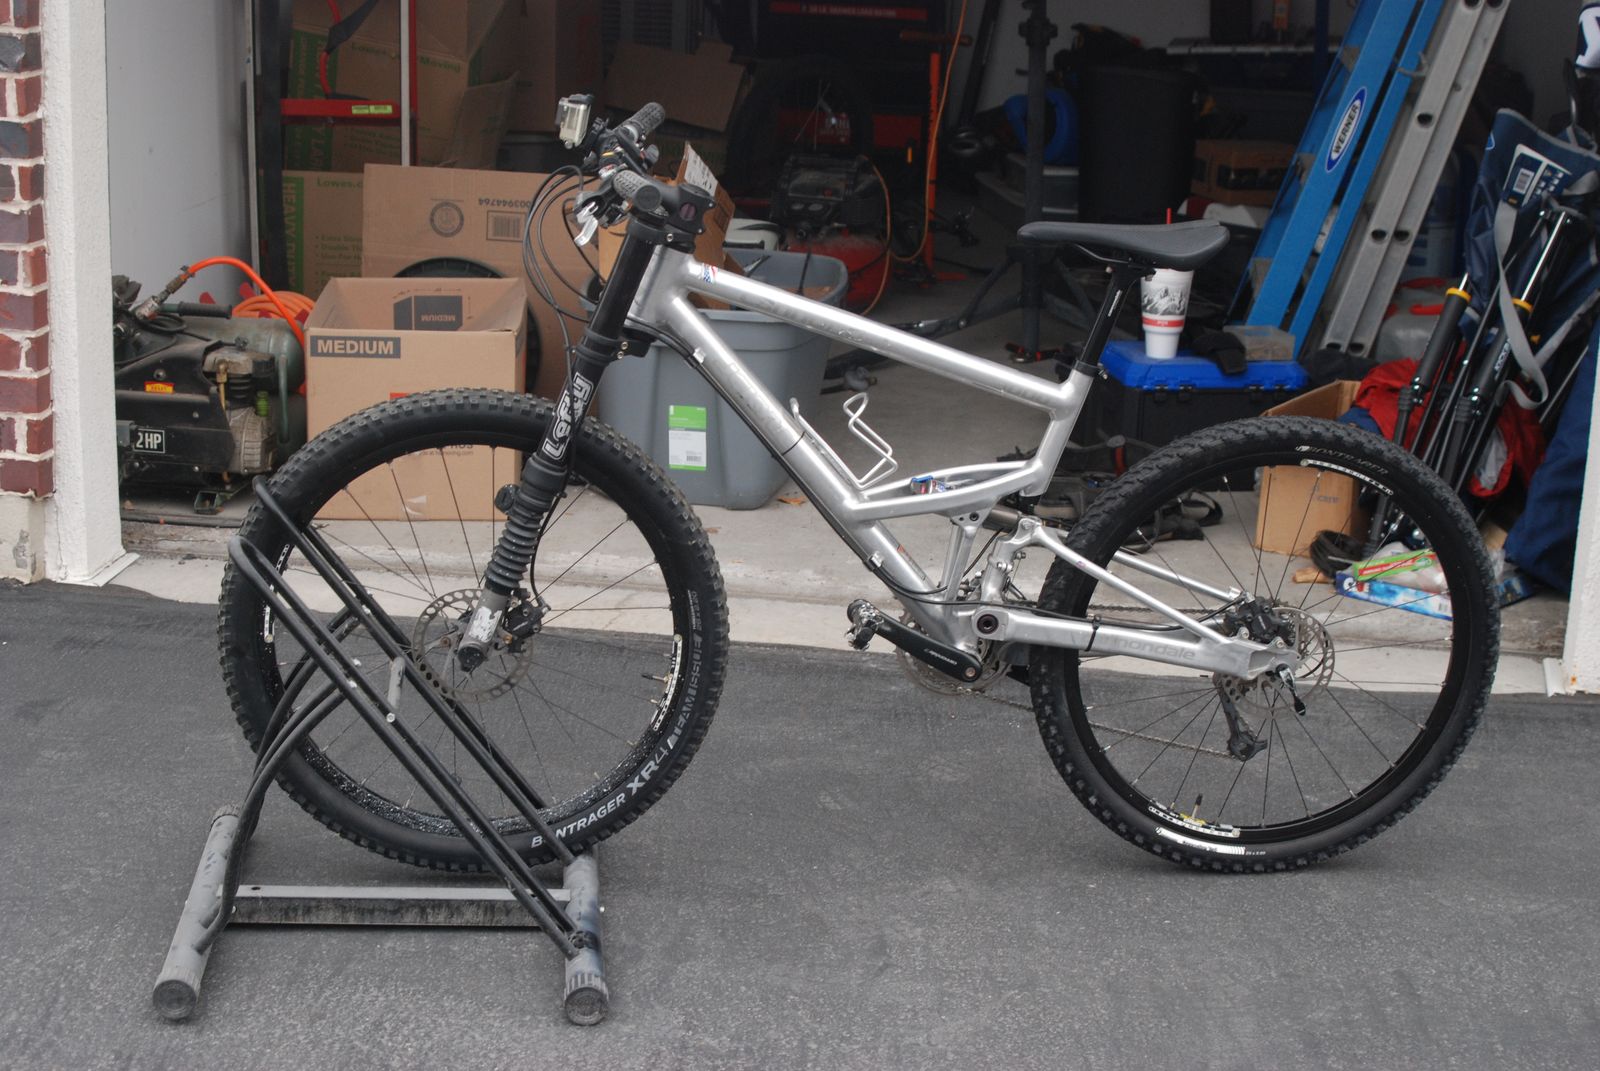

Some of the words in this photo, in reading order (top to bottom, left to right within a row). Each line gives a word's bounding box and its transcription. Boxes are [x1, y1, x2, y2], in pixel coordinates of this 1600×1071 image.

[1333, 103, 1358, 153] WERNER
[421, 314, 456, 322] MEDIUM
[317, 339, 393, 354] MEDIUM
[542, 372, 594, 460] Lefty
[531, 793, 627, 848] BNTRAGER
[626, 746, 669, 794] XR4
